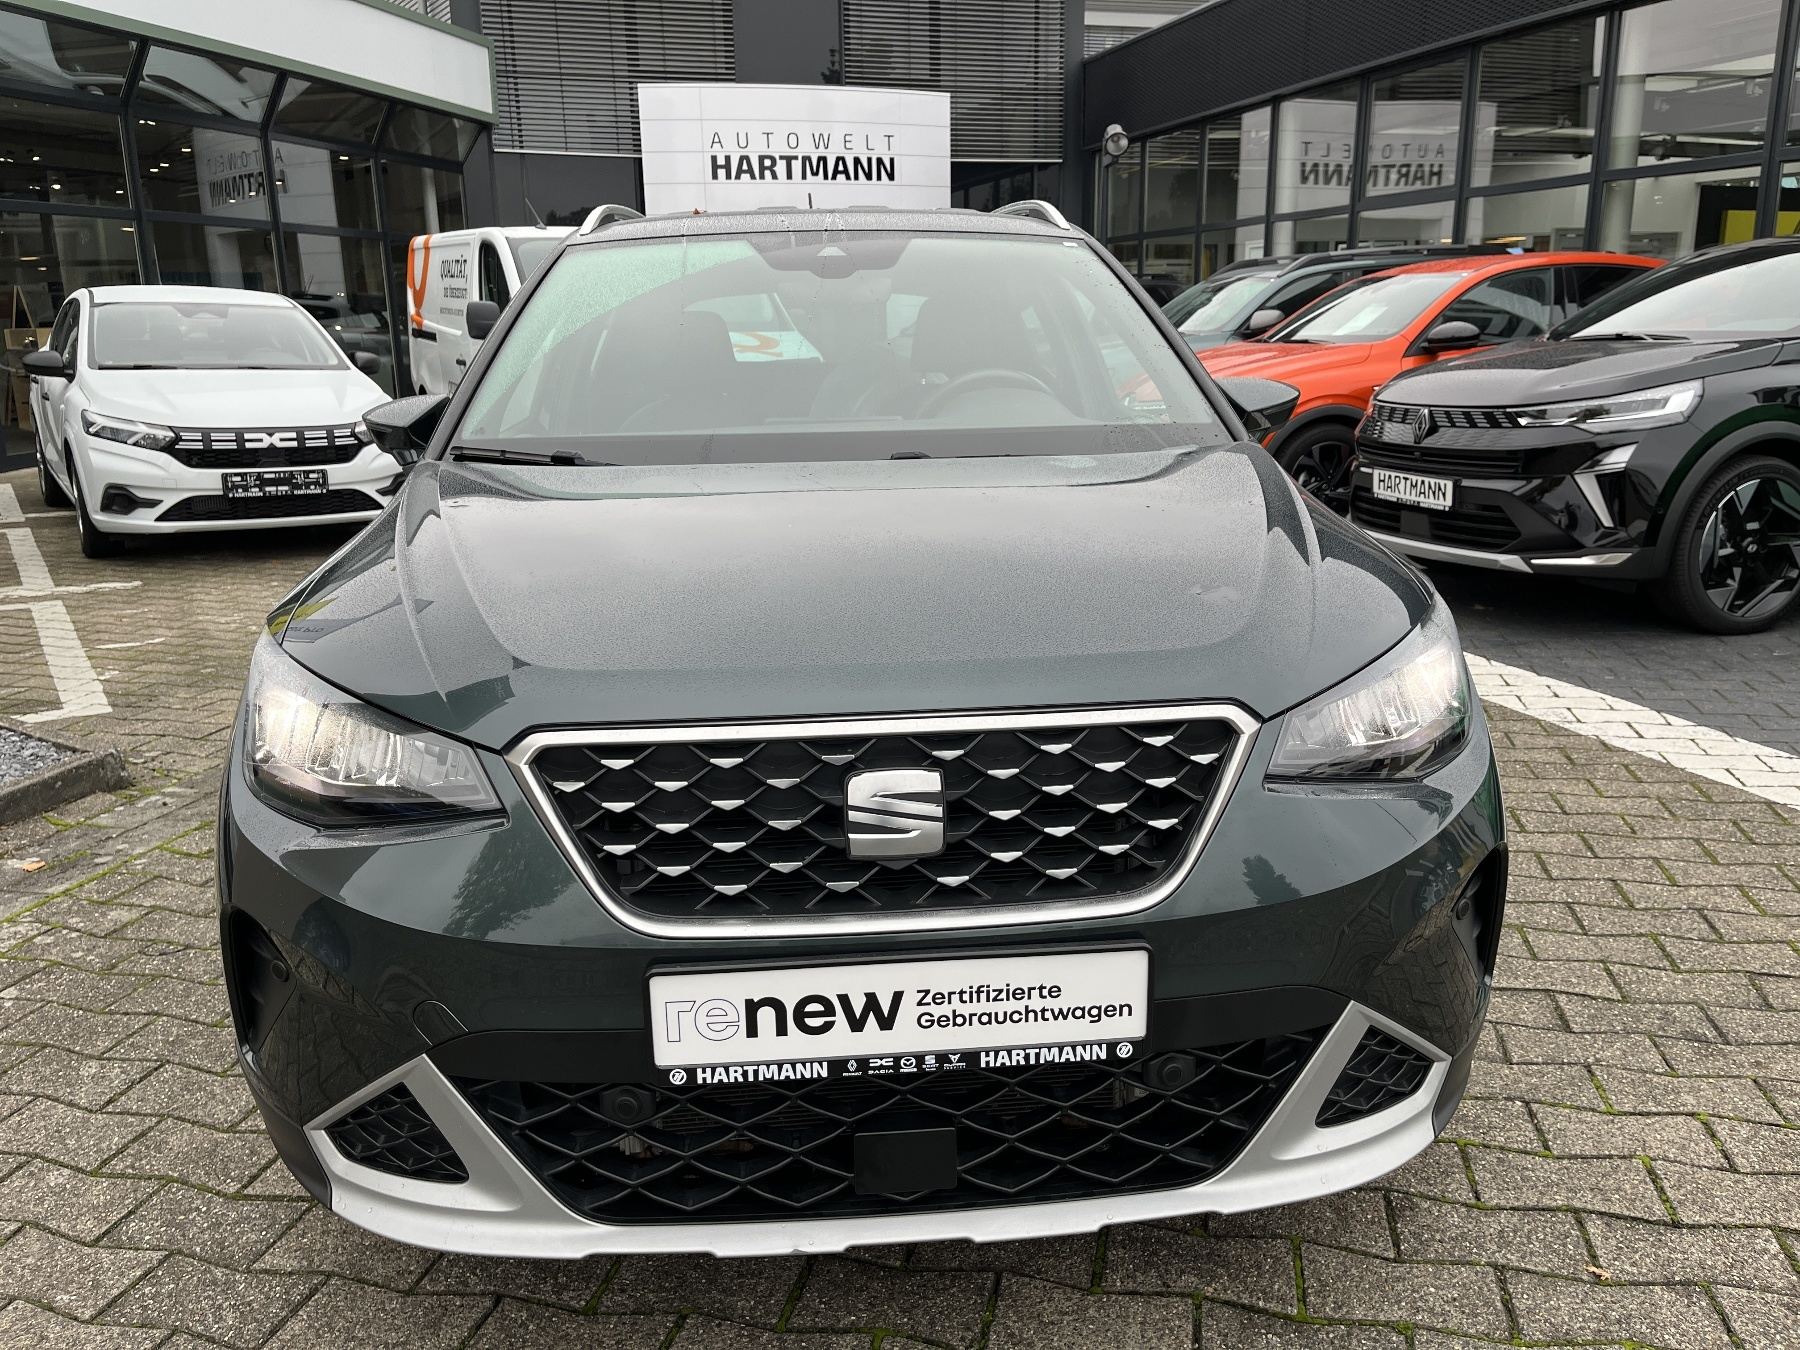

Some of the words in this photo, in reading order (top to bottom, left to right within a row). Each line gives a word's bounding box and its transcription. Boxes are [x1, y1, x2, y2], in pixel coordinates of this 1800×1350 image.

[710, 131, 895, 151] AUTOWELT
[710, 154, 895, 182] HARTMANN
[1378, 472, 1447, 502] HARTMANN
[916, 983, 1062, 1007] Zertifizierte
[665, 990, 905, 1043] renew
[916, 1003, 1133, 1030] Gebrauchtwagen
[980, 1043, 1107, 1068] HARTMANN
[696, 1061, 828, 1084] HARTMANN
